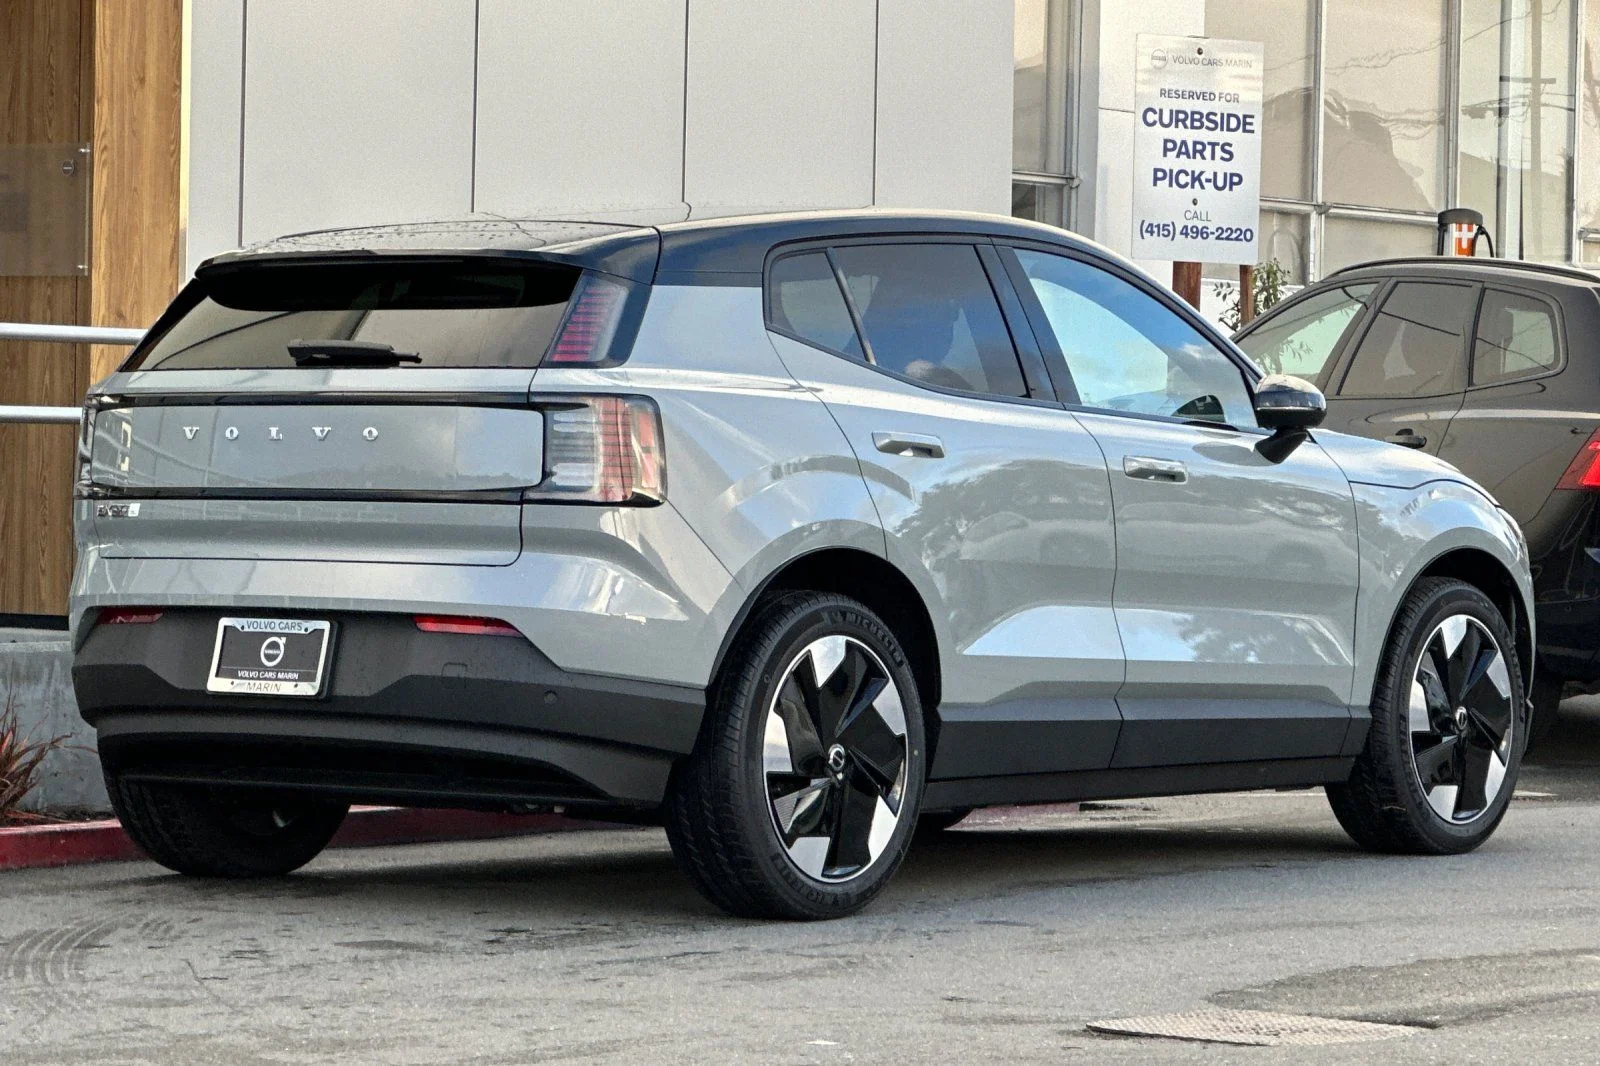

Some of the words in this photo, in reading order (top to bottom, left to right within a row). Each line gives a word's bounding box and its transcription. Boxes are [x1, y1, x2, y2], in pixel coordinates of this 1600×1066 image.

[1172, 55, 1200, 66] VOLVO
[1201, 58, 1223, 67] CARS
[1225, 59, 1252, 68] MARIN
[1159, 88, 1216, 101] RESERVED
[1218, 92, 1240, 103] FOR
[1142, 107, 1255, 134] CURBSIDE
[1162, 138, 1234, 162] PARTS
[1152, 167, 1243, 192] PICK-UP
[1184, 209, 1212, 222] CALL
[1139, 220, 1176, 241] (415)
[1179, 224, 1254, 243] 496-2220
[183, 426, 379, 441] VOLVO
[246, 620, 276, 631] VOLVO
[278, 621, 302, 631] CARS
[238, 670, 259, 678] VOLVO
[260, 671, 277, 679] CARS
[277, 672, 299, 680] MARIN
[246, 682, 282, 693] MARIN
